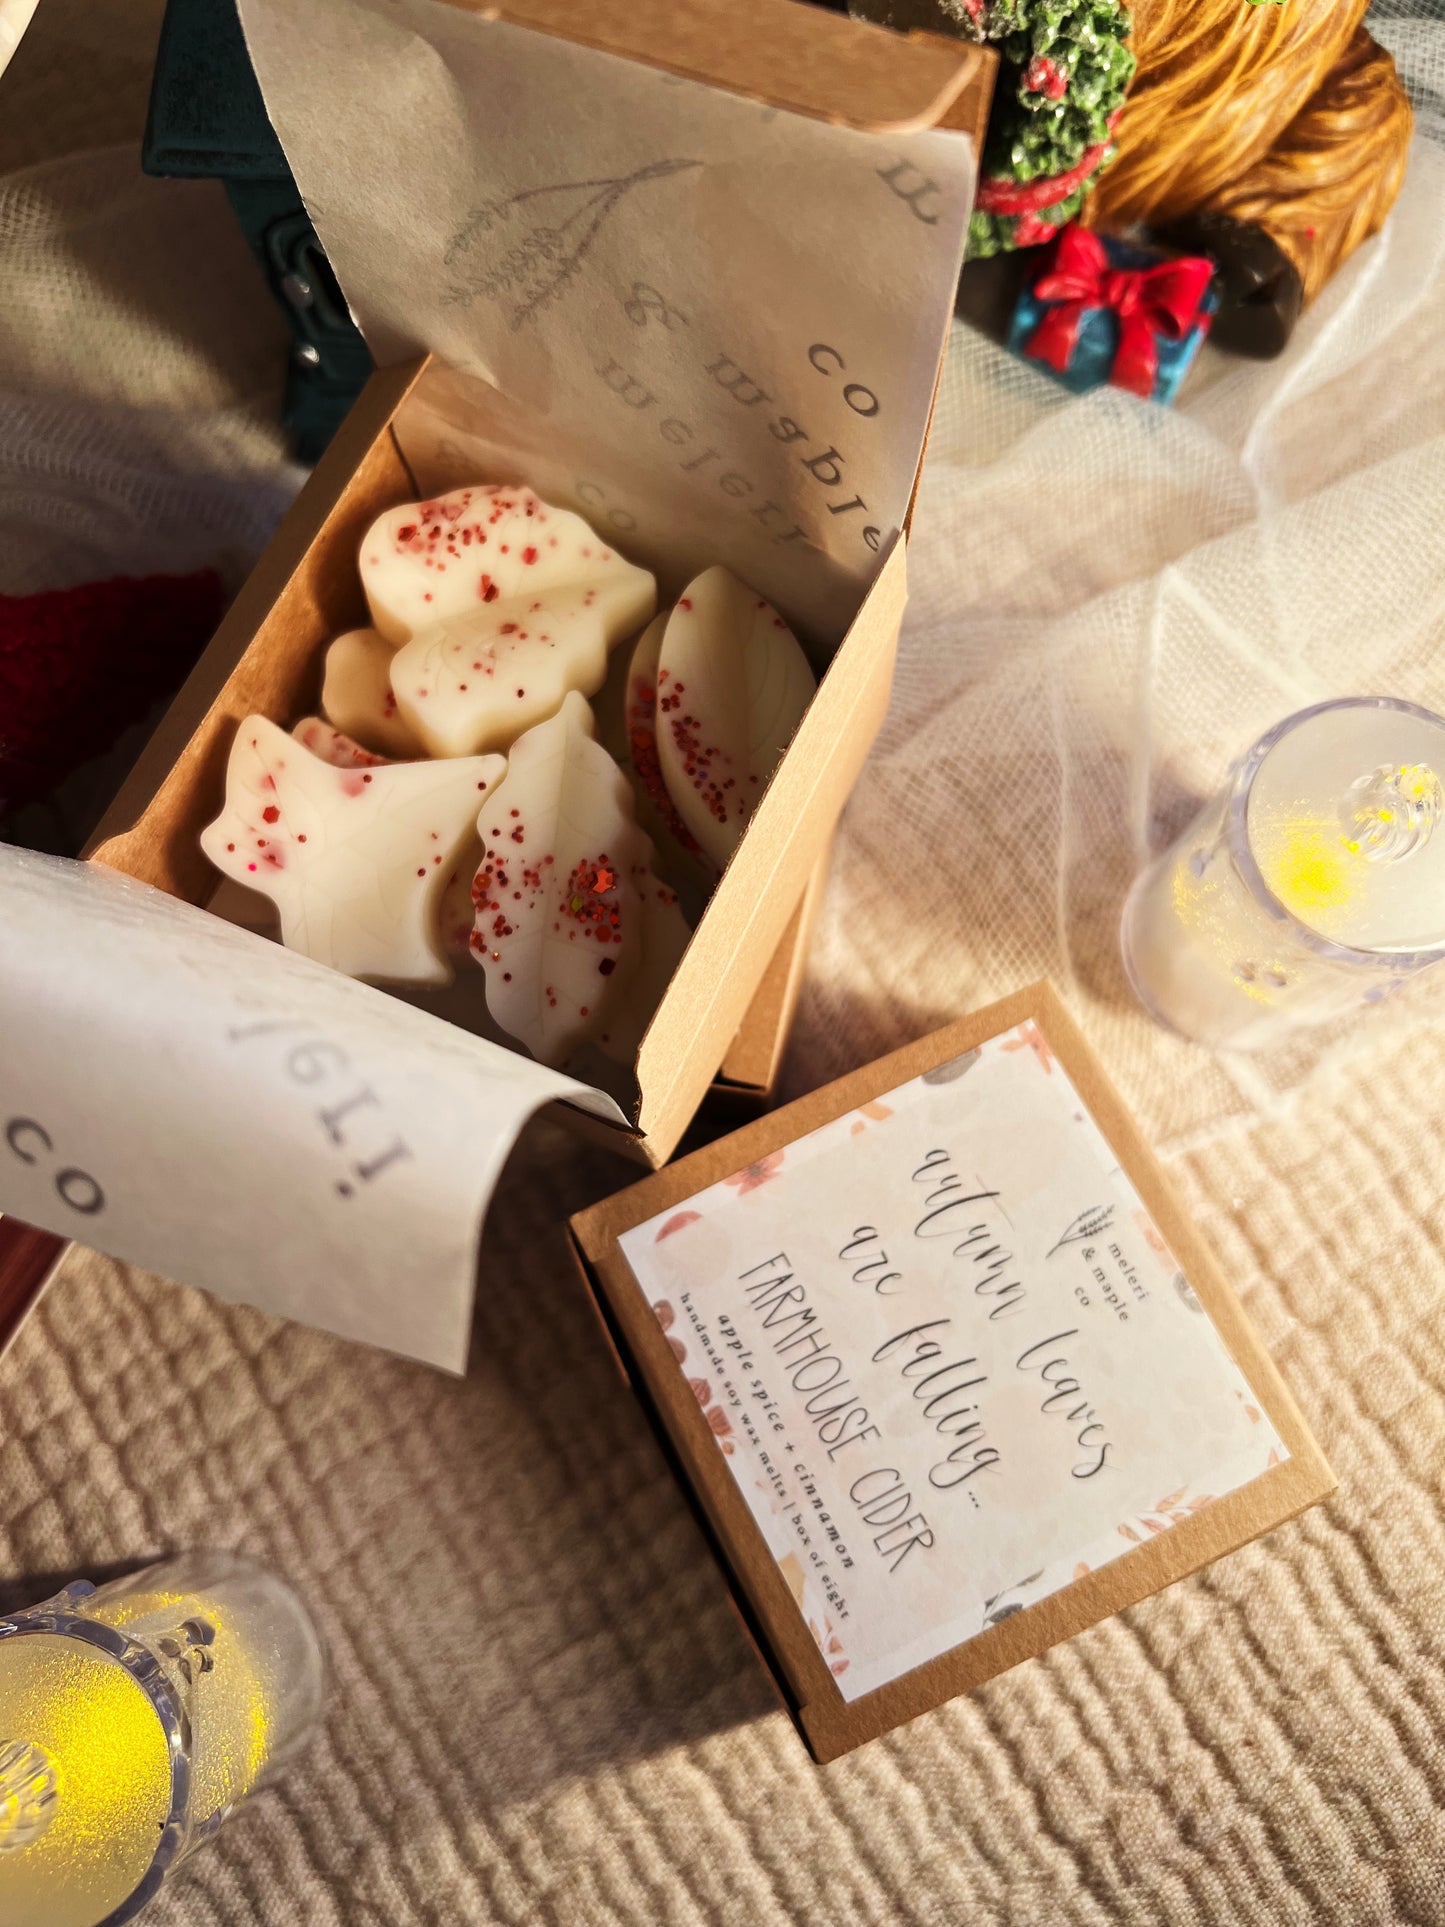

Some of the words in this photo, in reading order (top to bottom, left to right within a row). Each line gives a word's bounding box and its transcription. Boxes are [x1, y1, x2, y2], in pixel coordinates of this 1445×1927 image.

[838, 1224, 903, 1296] are
[911, 1148, 1026, 1320] autumn
[1016, 1328, 1118, 1480] leaves
[1074, 1286, 1090, 1306] co
[1081, 1247, 1095, 1262] &
[1092, 1266, 1128, 1322] maple
[1109, 1243, 1149, 1301] meleri
[679, 1292, 726, 1376] handmade
[724, 1379, 743, 1406] soy
[740, 1412, 761, 1446] wax
[759, 1451, 787, 1498] melts
[791, 1513, 812, 1546] box
[810, 1550, 827, 1571] of
[821, 1573, 850, 1620] eight
[717, 1313, 754, 1372] apple
[752, 1379, 785, 1432] spice
[784, 1440, 796, 1454] +
[794, 1463, 856, 1570] cinnamon
[738, 1251, 883, 1463] FARMHOUSE
[849, 1467, 936, 1573] CIDER
